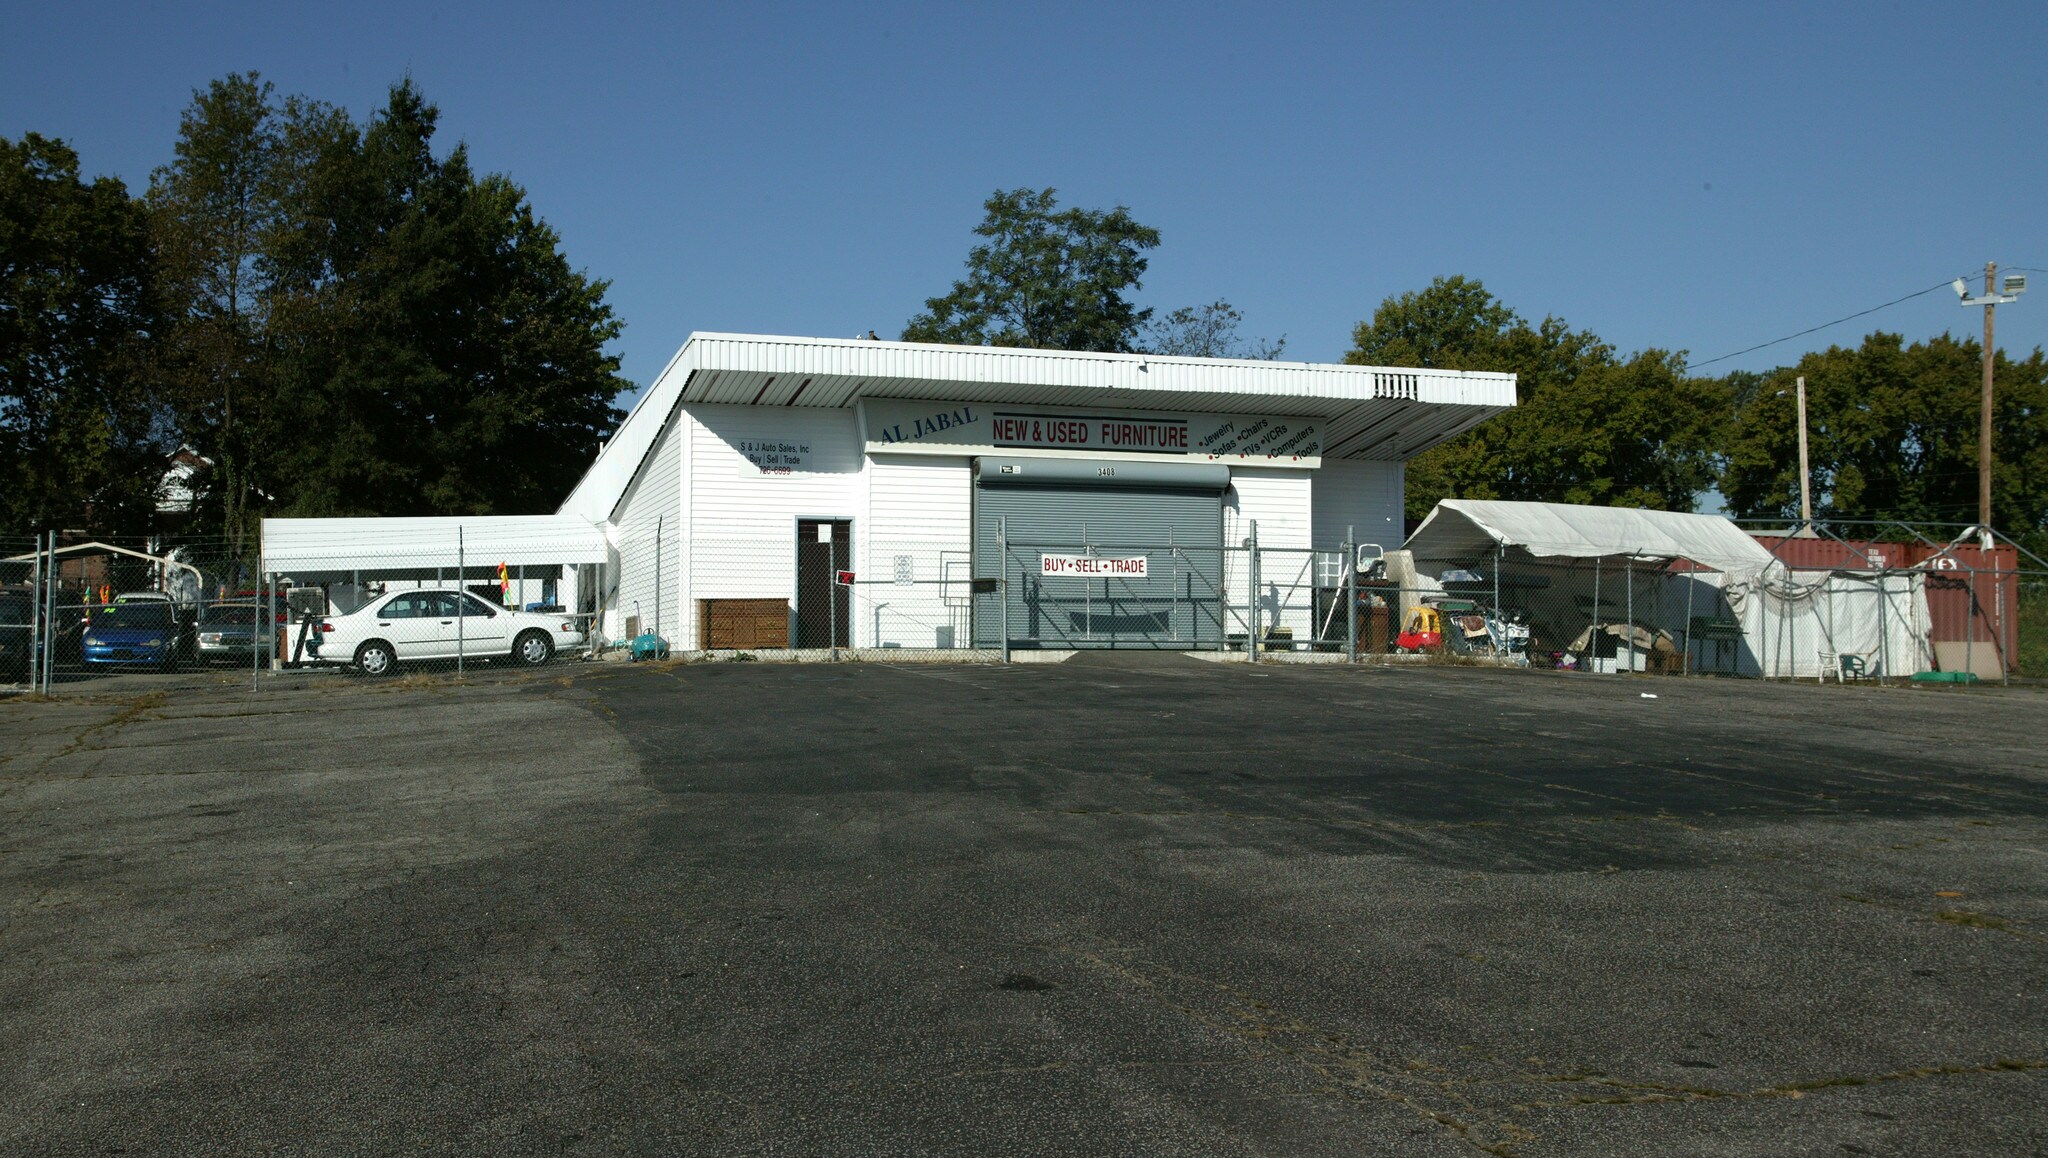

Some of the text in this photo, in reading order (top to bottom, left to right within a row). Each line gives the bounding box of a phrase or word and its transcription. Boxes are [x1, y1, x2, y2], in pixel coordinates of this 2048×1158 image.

[881, 406, 978, 446] AL JABAL
[993, 419, 1187, 447] NEW & USED FURNITURE
[1203, 421, 1235, 447] Jewelry
[1212, 418, 1268, 459] Sofas Chairs
[740, 441, 746, 451] S
[747, 442, 753, 451] &
[755, 442, 760, 451] J
[761, 443, 776, 452] Auto
[799, 444, 809, 453] Inc
[1243, 425, 1288, 457] TVs VCRs
[1271, 425, 1315, 458] Computers
[1295, 441, 1319, 460] Tools
[749, 454, 800, 464] Buy Sell Trade
[1097, 467, 1116, 477] 3408
[1044, 558, 1144, 573] BUY SELL TRADE
